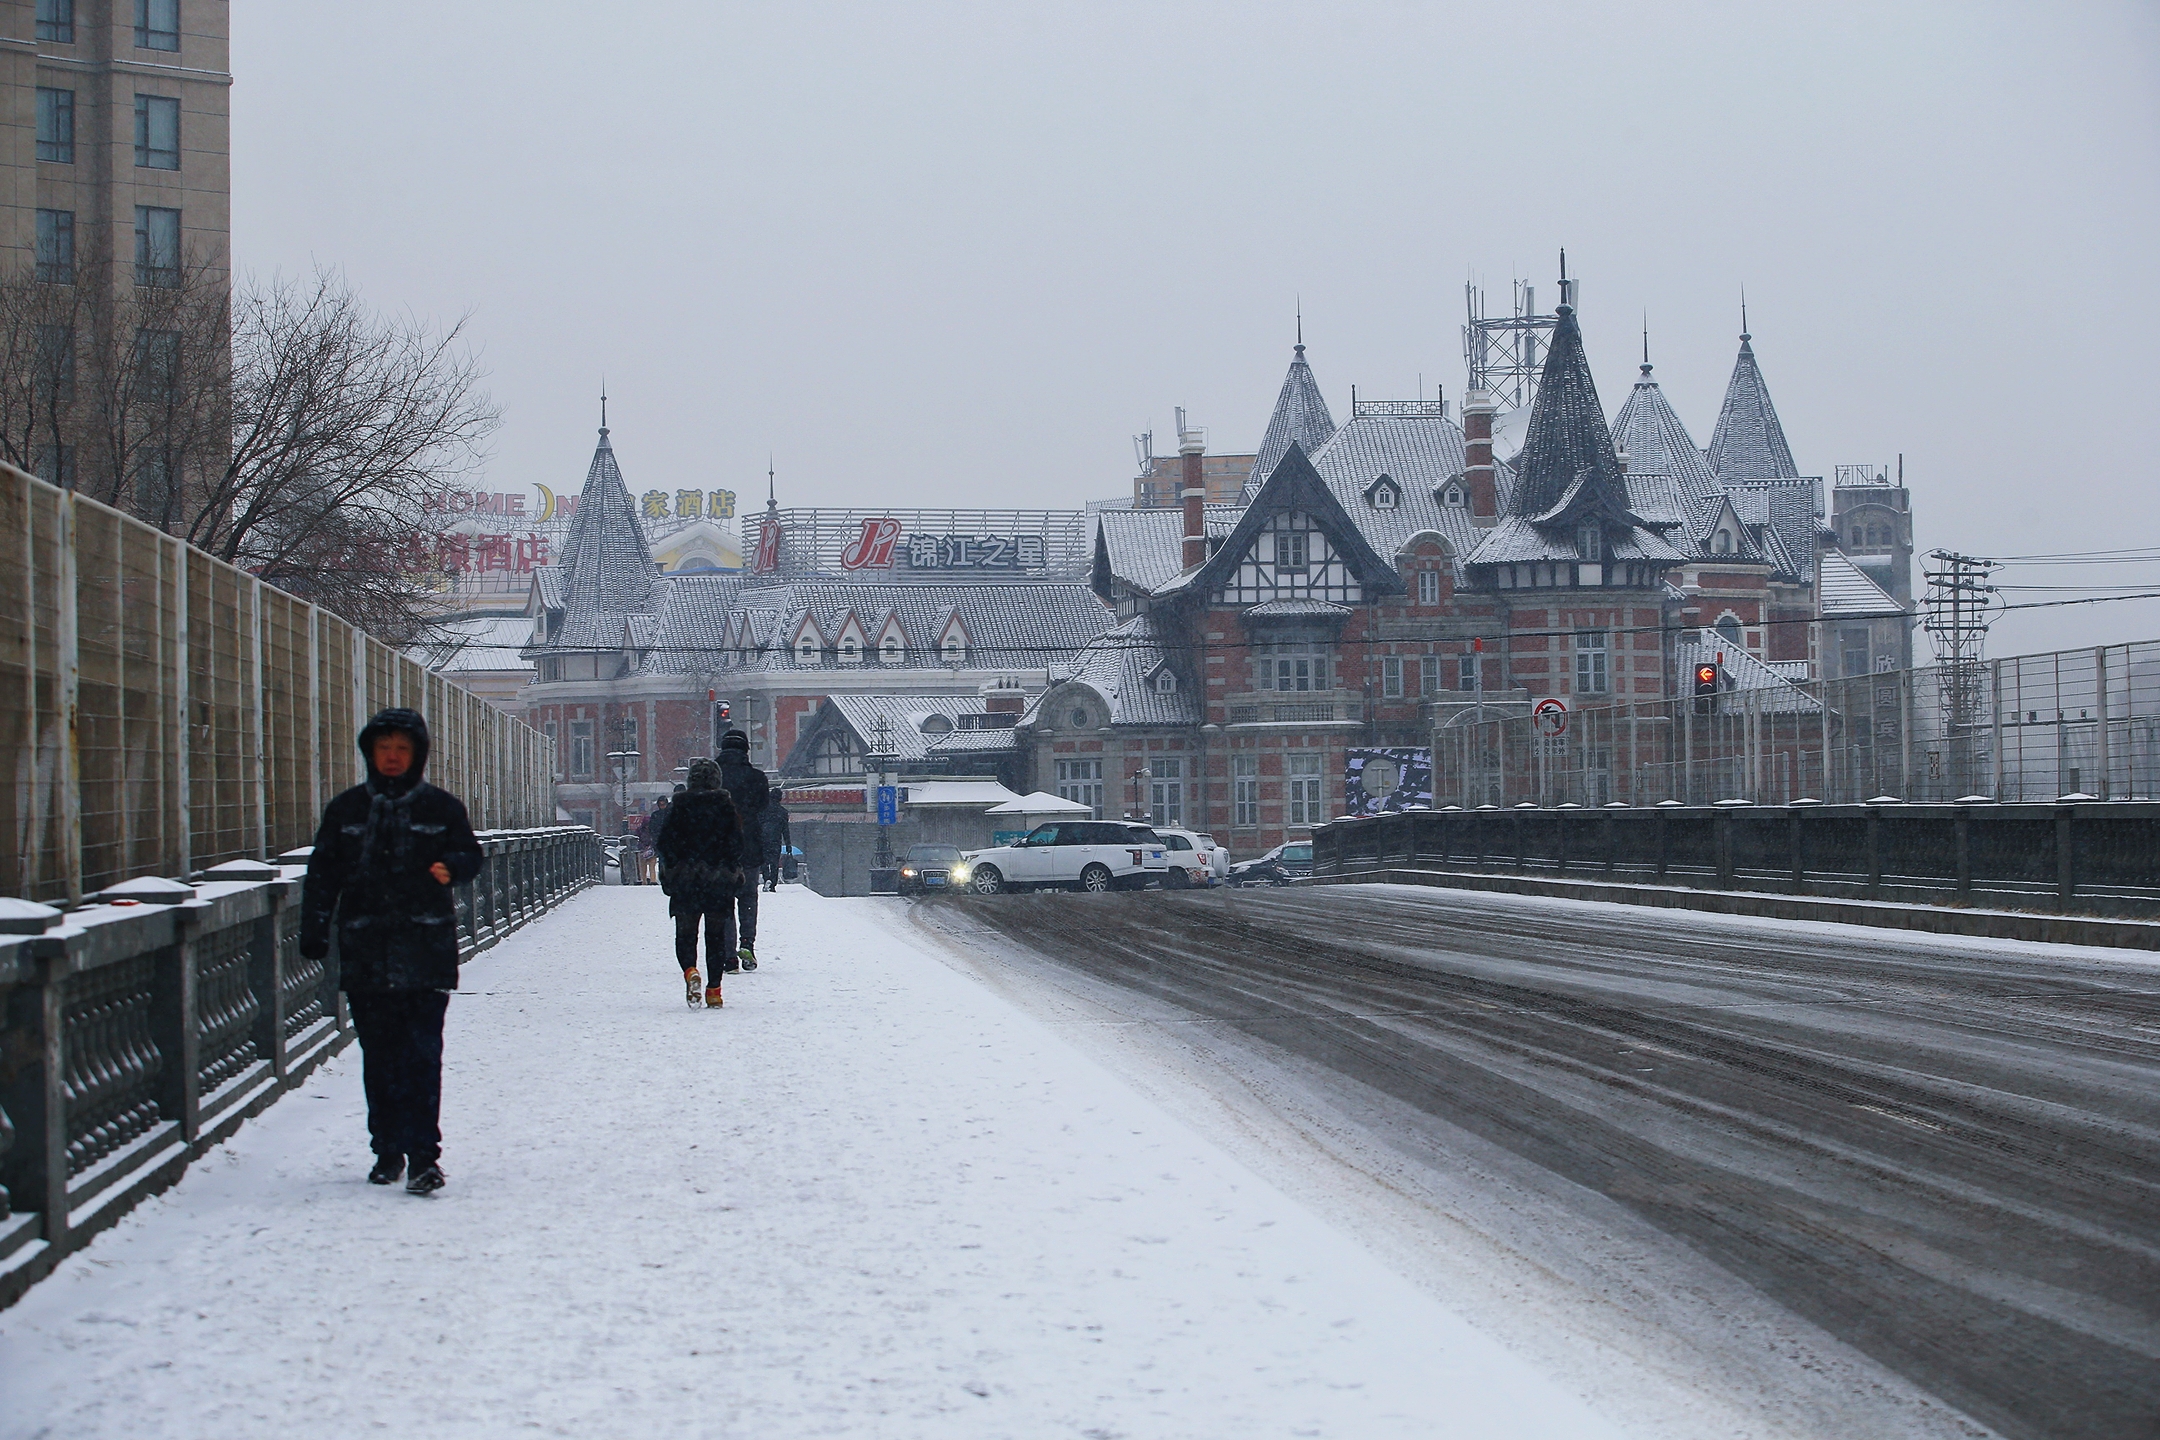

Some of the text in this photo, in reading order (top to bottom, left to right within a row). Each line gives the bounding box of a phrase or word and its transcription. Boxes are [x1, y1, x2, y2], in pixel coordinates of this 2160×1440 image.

[423, 491, 526, 516] HOME
[629, 488, 736, 519] 家酒店
[907, 534, 1045, 567] 锦江之星
